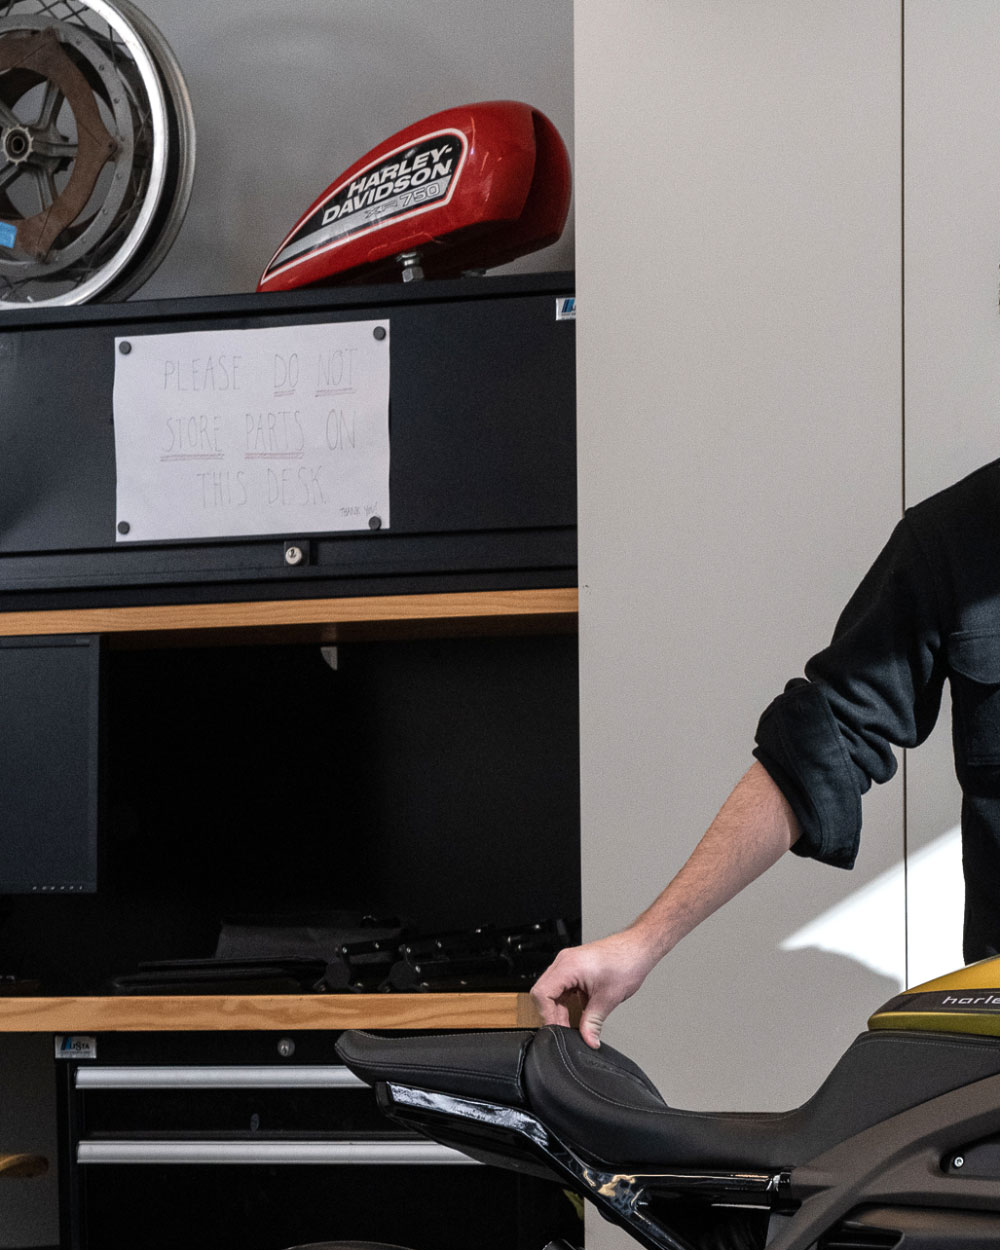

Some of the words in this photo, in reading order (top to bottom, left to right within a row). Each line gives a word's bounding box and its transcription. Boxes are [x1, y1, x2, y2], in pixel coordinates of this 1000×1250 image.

[321, 159, 453, 226] DAVIDSON
[347, 144, 453, 199] HARLEY-
[399, 182, 441, 207] 750
[163, 355, 242, 391] PLEASE
[273, 353, 300, 389] DO
[316, 348, 358, 387] NOT
[161, 415, 223, 453] STORE
[245, 410, 305, 452] PARTS
[325, 408, 356, 451] ON
[196, 470, 249, 508] THIS
